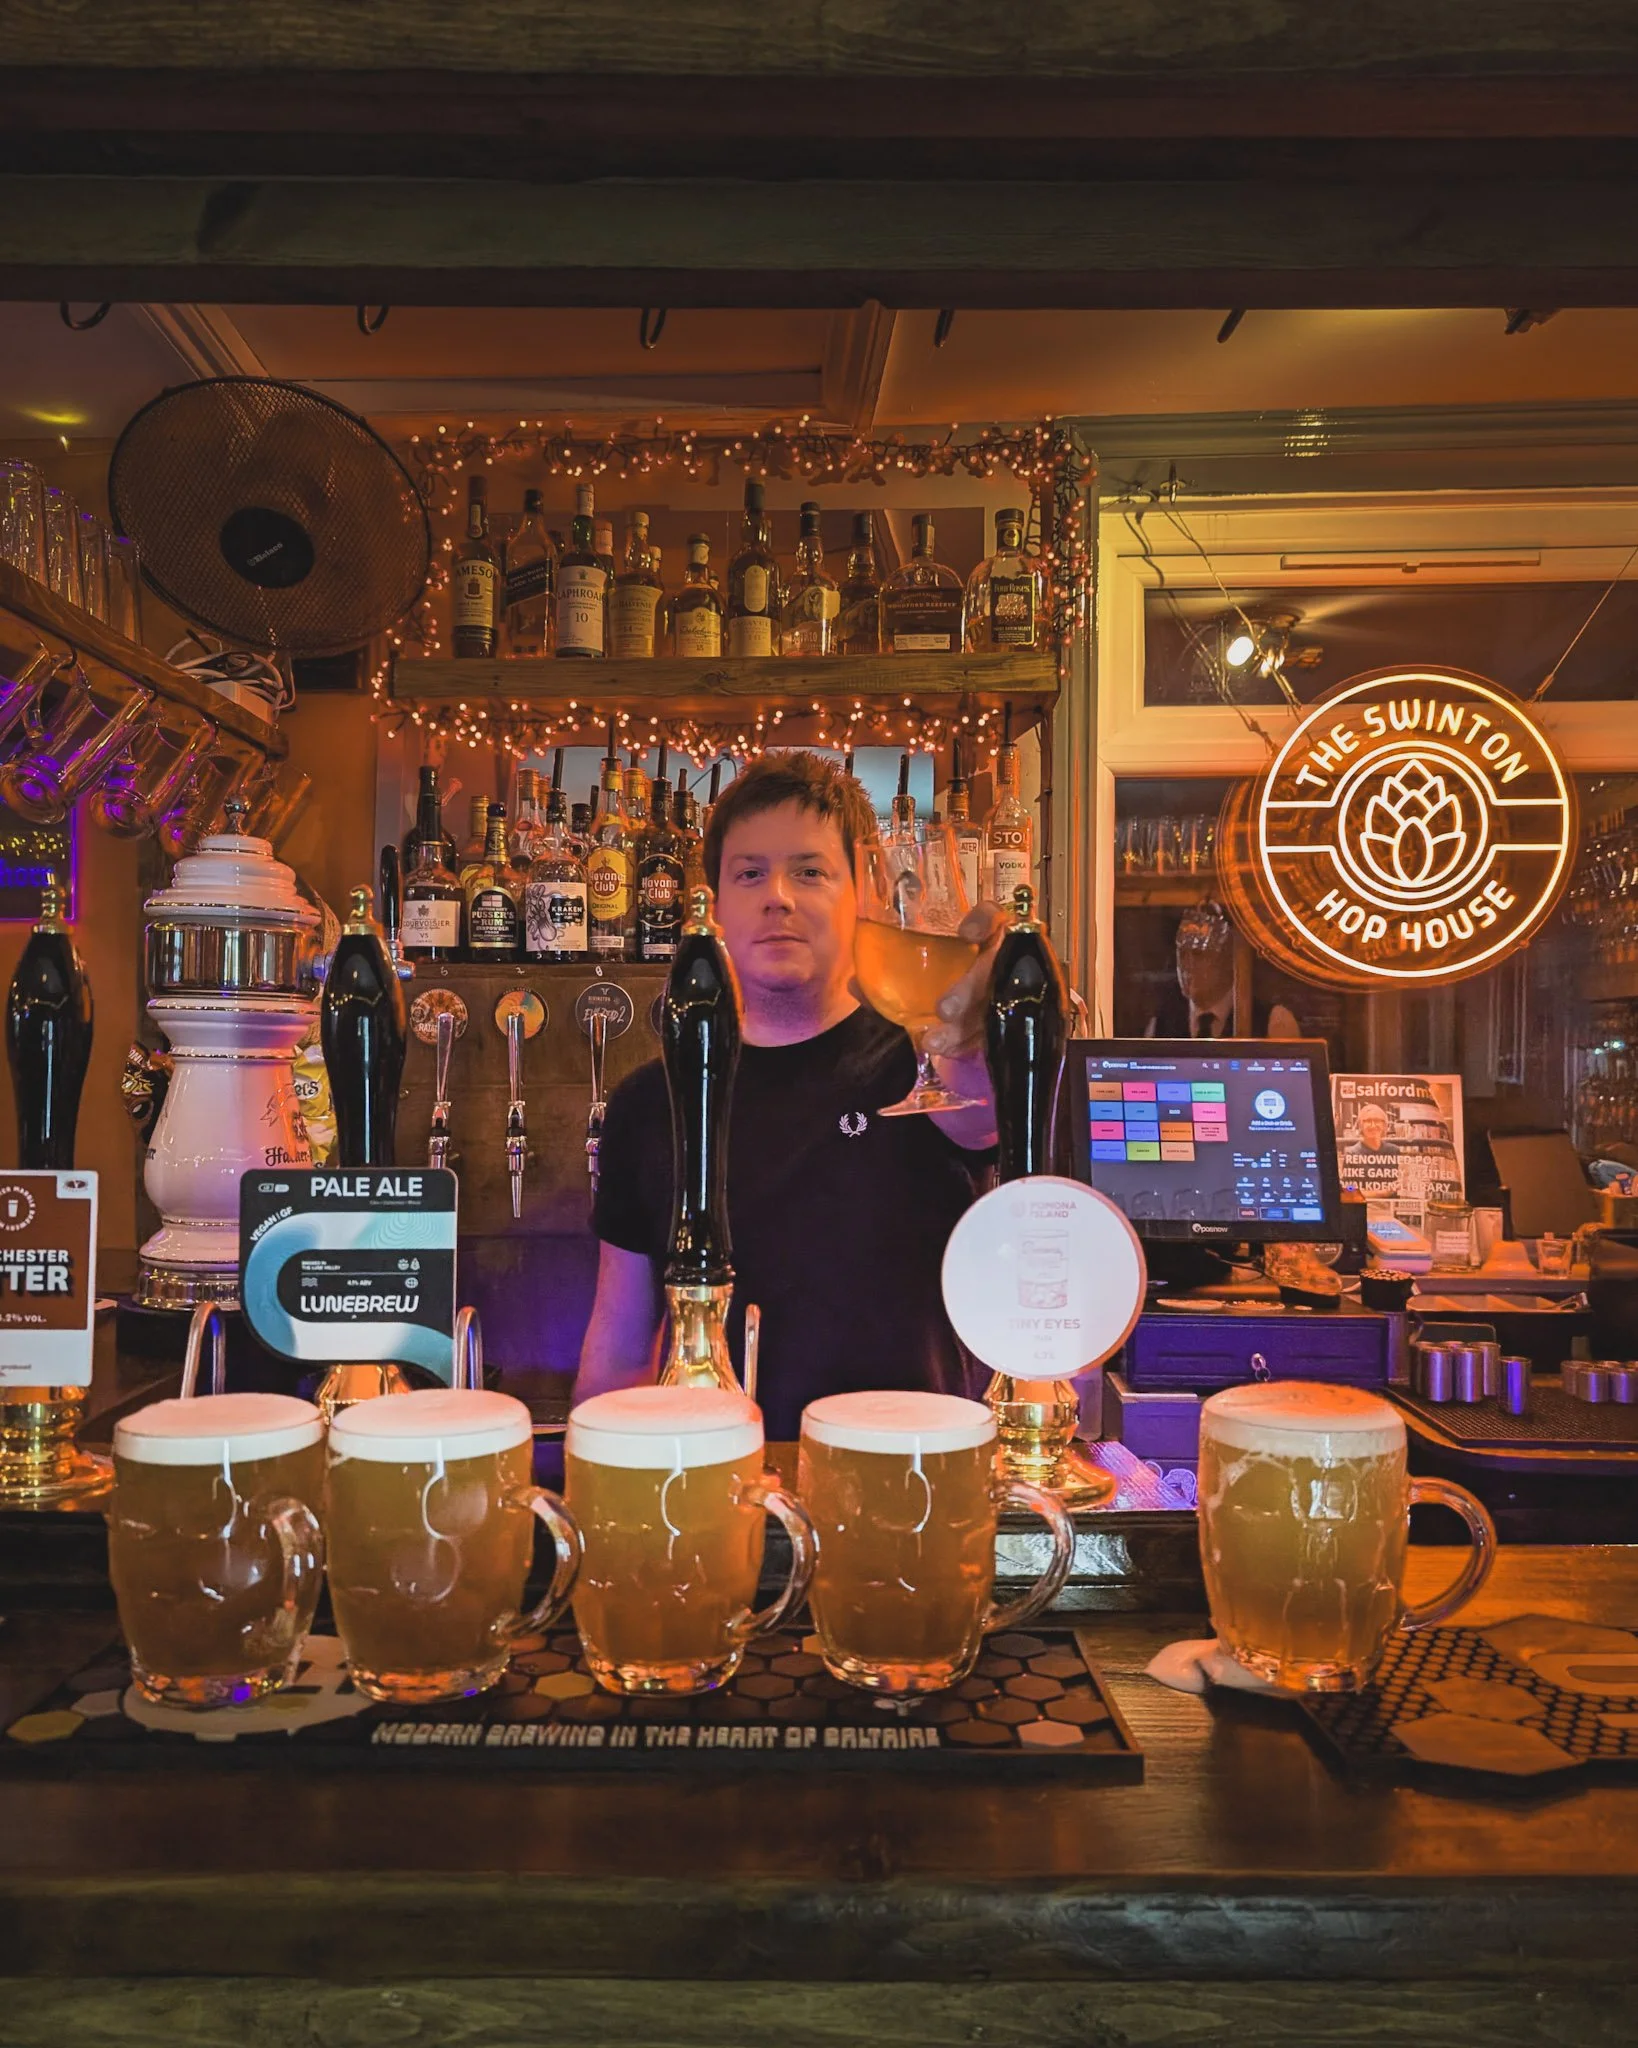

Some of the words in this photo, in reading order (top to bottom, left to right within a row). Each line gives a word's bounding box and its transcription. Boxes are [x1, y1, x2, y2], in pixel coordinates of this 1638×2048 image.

[575, 612, 589, 623] 10
[1295, 722, 1360, 788] THE
[1363, 698, 1529, 784] SWINTON
[998, 861, 1027, 870] VODKA
[594, 881, 616, 892] Club
[641, 877, 679, 889] Havana
[648, 889, 671, 899] Club
[471, 910, 515, 919] PUSSER'S
[655, 910, 664, 921] 7
[1315, 888, 1388, 943] HOP
[1400, 880, 1516, 952] HOUSE
[403, 919, 450, 927] COURVOISIER
[1345, 1154, 1412, 1165] RENOWNED
[1415, 1155, 1446, 1166] POET
[1367, 1168, 1405, 1178] GARRY
[1408, 1169, 1456, 1180] VISITED
[310, 1176, 371, 1198] PALE
[375, 1176, 424, 1198] ALE
[1341, 1180, 1398, 1191] WALKDEN
[1399, 1181, 1452, 1193] LIBRARY
[249, 1214, 278, 1243] VEGAN
[279, 1205, 294, 1218] GF
[300, 1294, 419, 1313] LUNEBREW
[1009, 1318, 1041, 1330] TINY
[1044, 1318, 1081, 1330] EYES
[371, 1721, 483, 1746] MODERN
[485, 1722, 606, 1748] BREWING
[609, 1724, 638, 1748] IN
[645, 1724, 691, 1748] THE
[696, 1724, 779, 1749] HEART
[785, 1724, 817, 1749] OF
